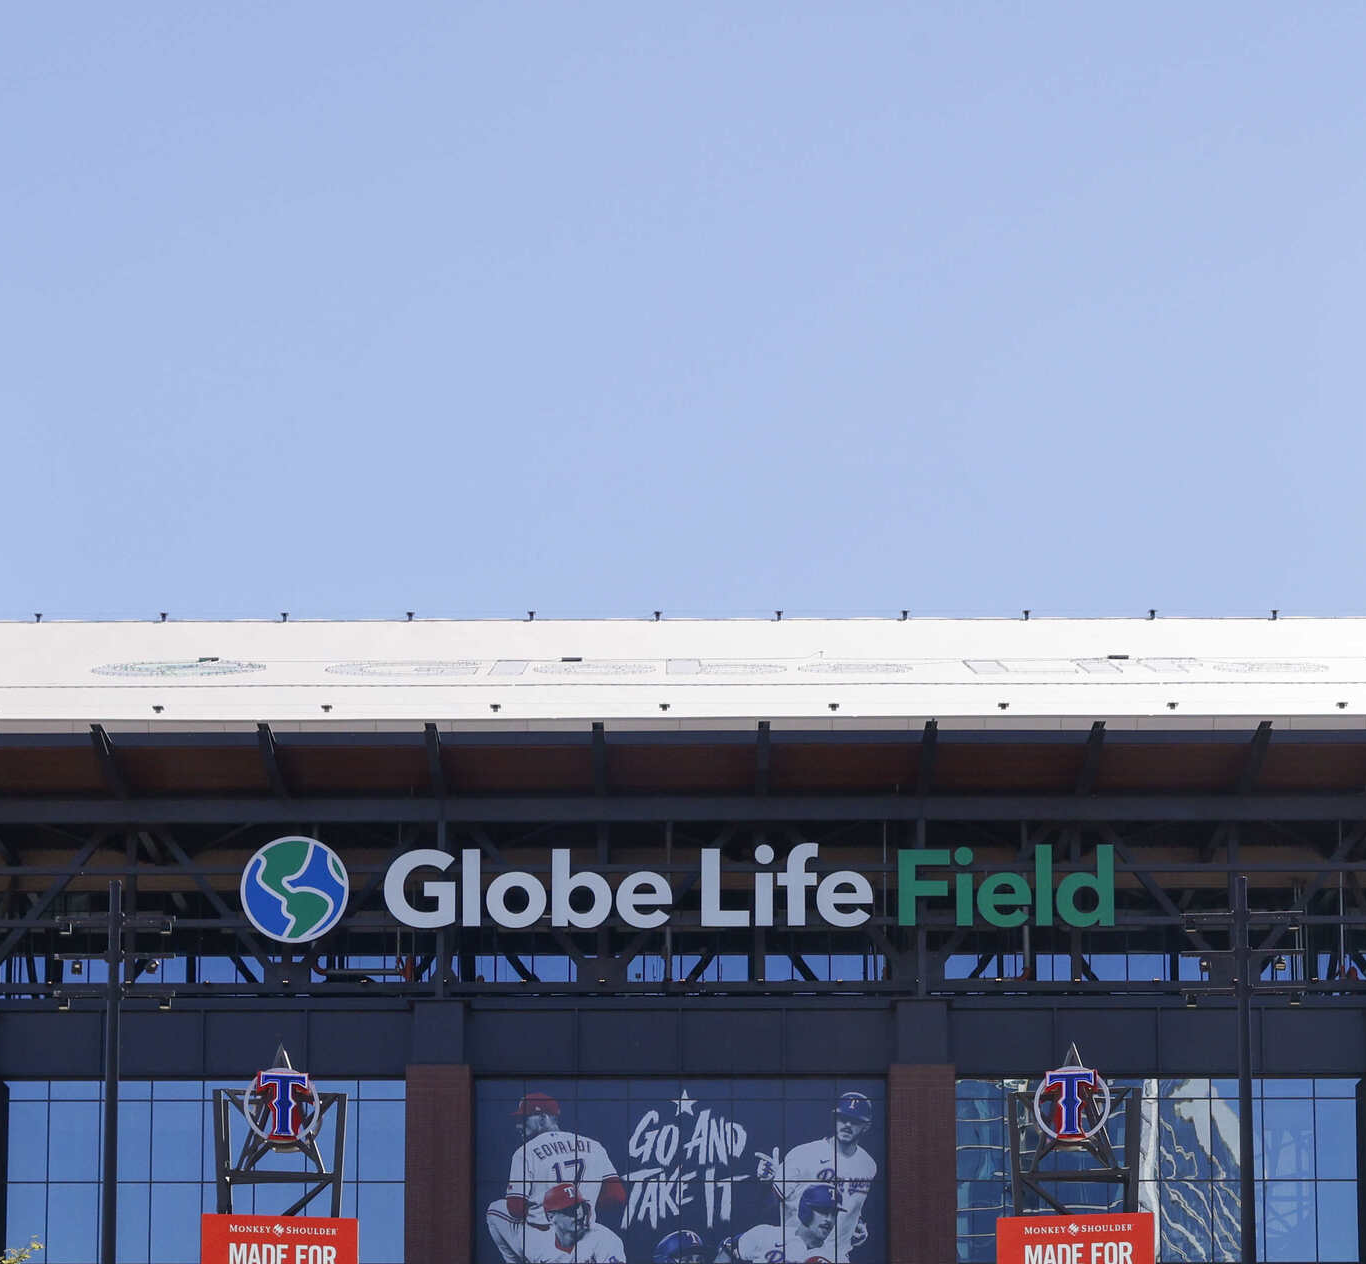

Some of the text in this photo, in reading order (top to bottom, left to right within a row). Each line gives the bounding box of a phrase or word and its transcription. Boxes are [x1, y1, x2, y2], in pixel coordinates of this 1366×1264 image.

[384, 842, 1115, 928] Globe Life Field
[629, 1109, 747, 1166] GO AND
[534, 1140, 592, 1160] EOVALDI
[551, 1158, 586, 1182] 17
[621, 1165, 751, 1230] TAKE IT
[229, 1224, 337, 1236] MONKEY SHOULDER
[1024, 1223, 1133, 1235] MONKEY SHOULDER
